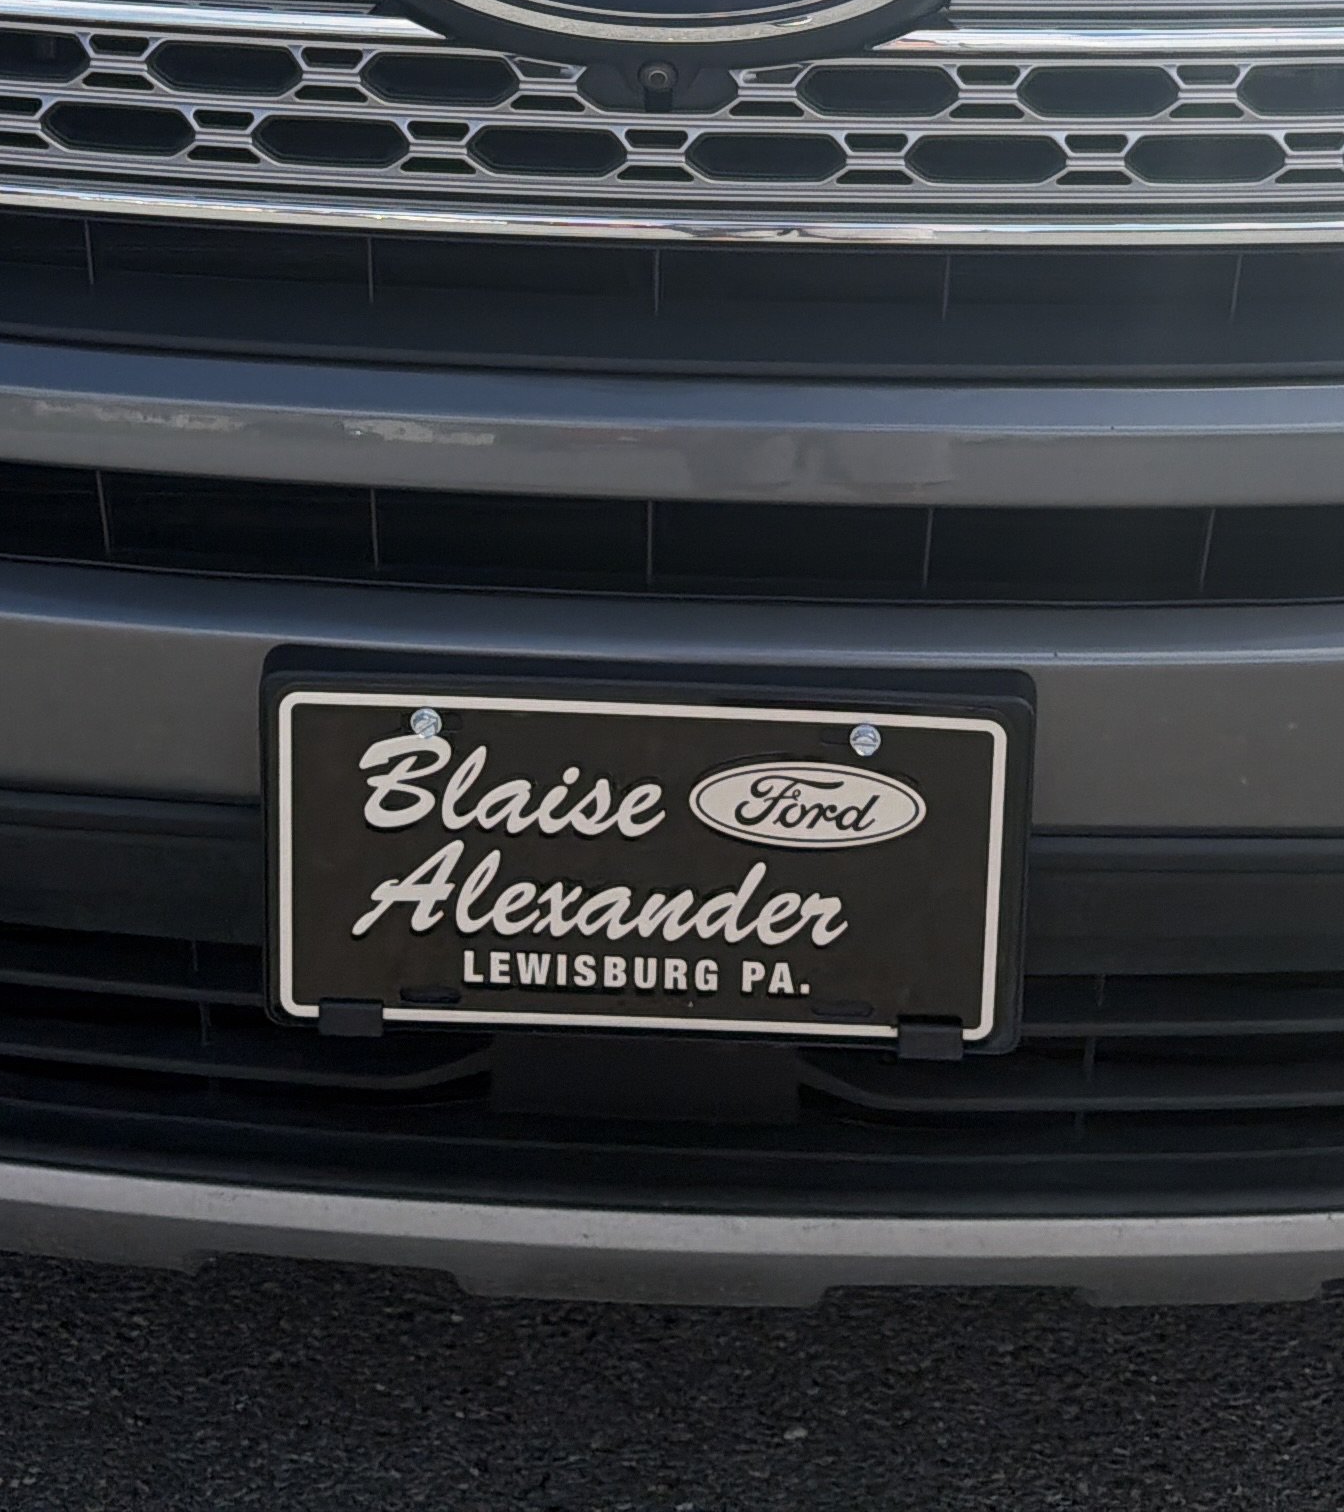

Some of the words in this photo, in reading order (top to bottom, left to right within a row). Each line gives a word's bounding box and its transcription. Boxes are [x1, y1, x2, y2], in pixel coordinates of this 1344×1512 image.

[359, 734, 665, 838] Blaise
[735, 775, 880, 833] Ford
[352, 839, 848, 946] Alexander
[464, 950, 719, 992] LEWISBURG
[742, 961, 810, 994] PA.
